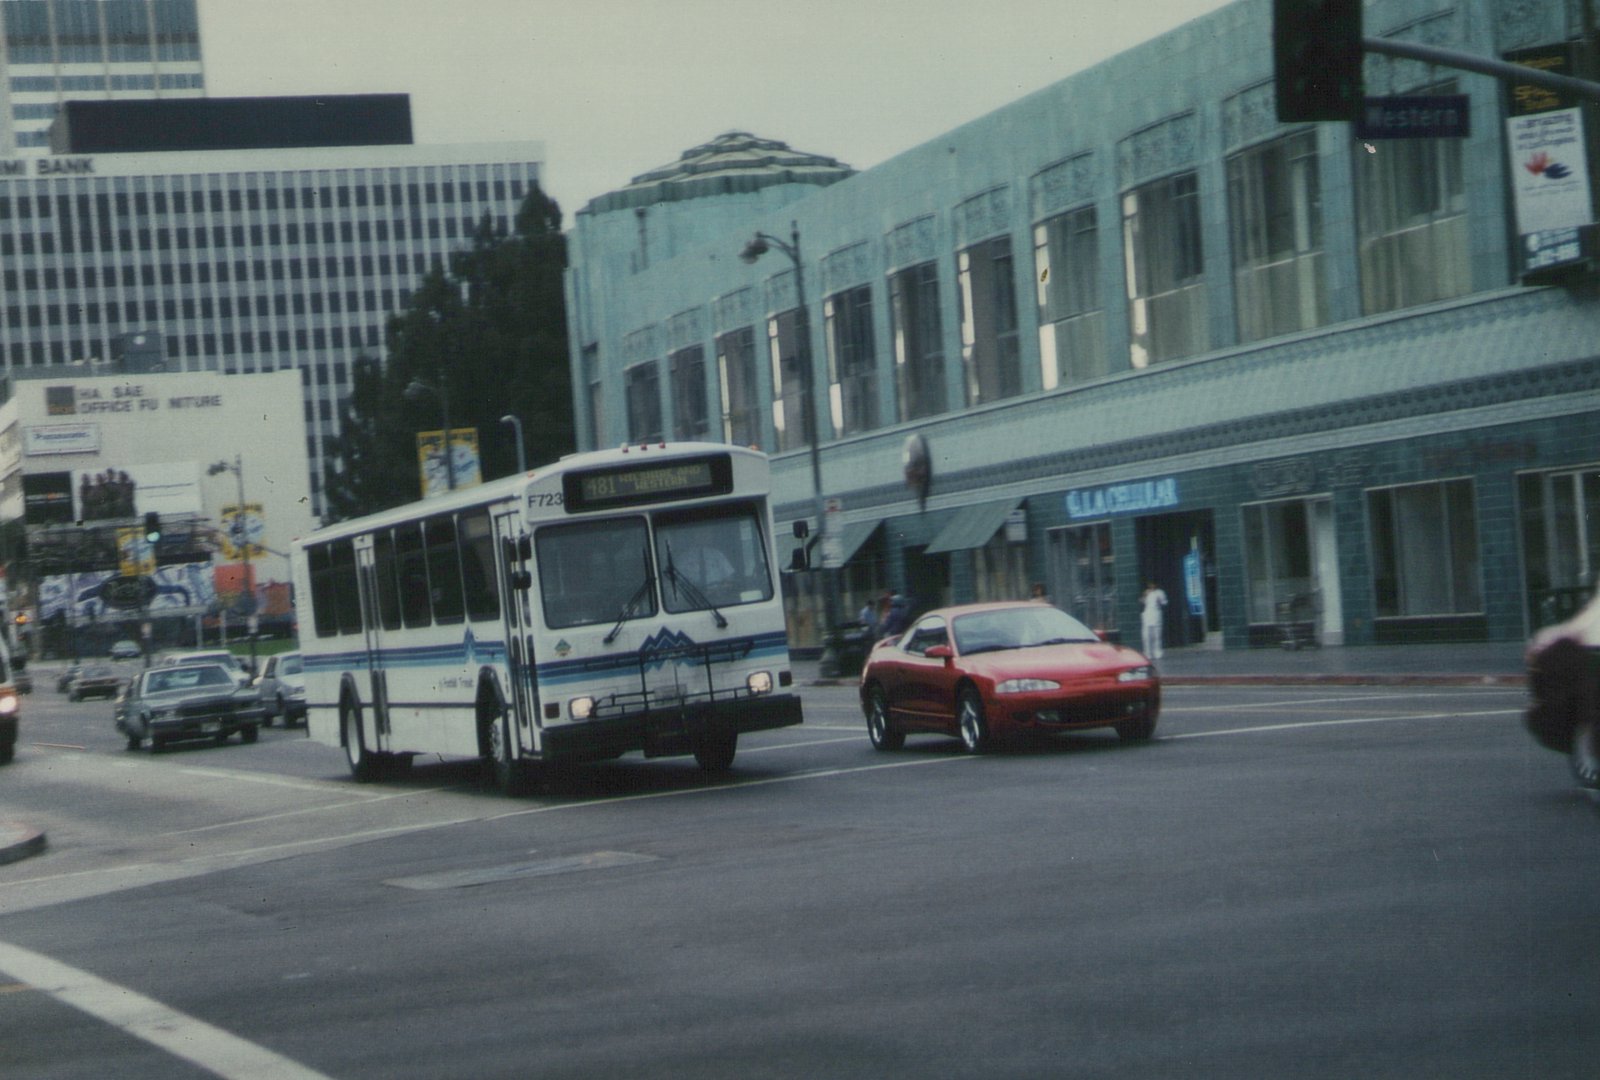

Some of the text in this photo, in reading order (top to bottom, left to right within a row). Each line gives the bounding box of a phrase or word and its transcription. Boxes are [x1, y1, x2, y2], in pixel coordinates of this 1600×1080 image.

[37, 157, 95, 174] BANK
[80, 400, 132, 413] OFFICE
[528, 492, 564, 508] F723
